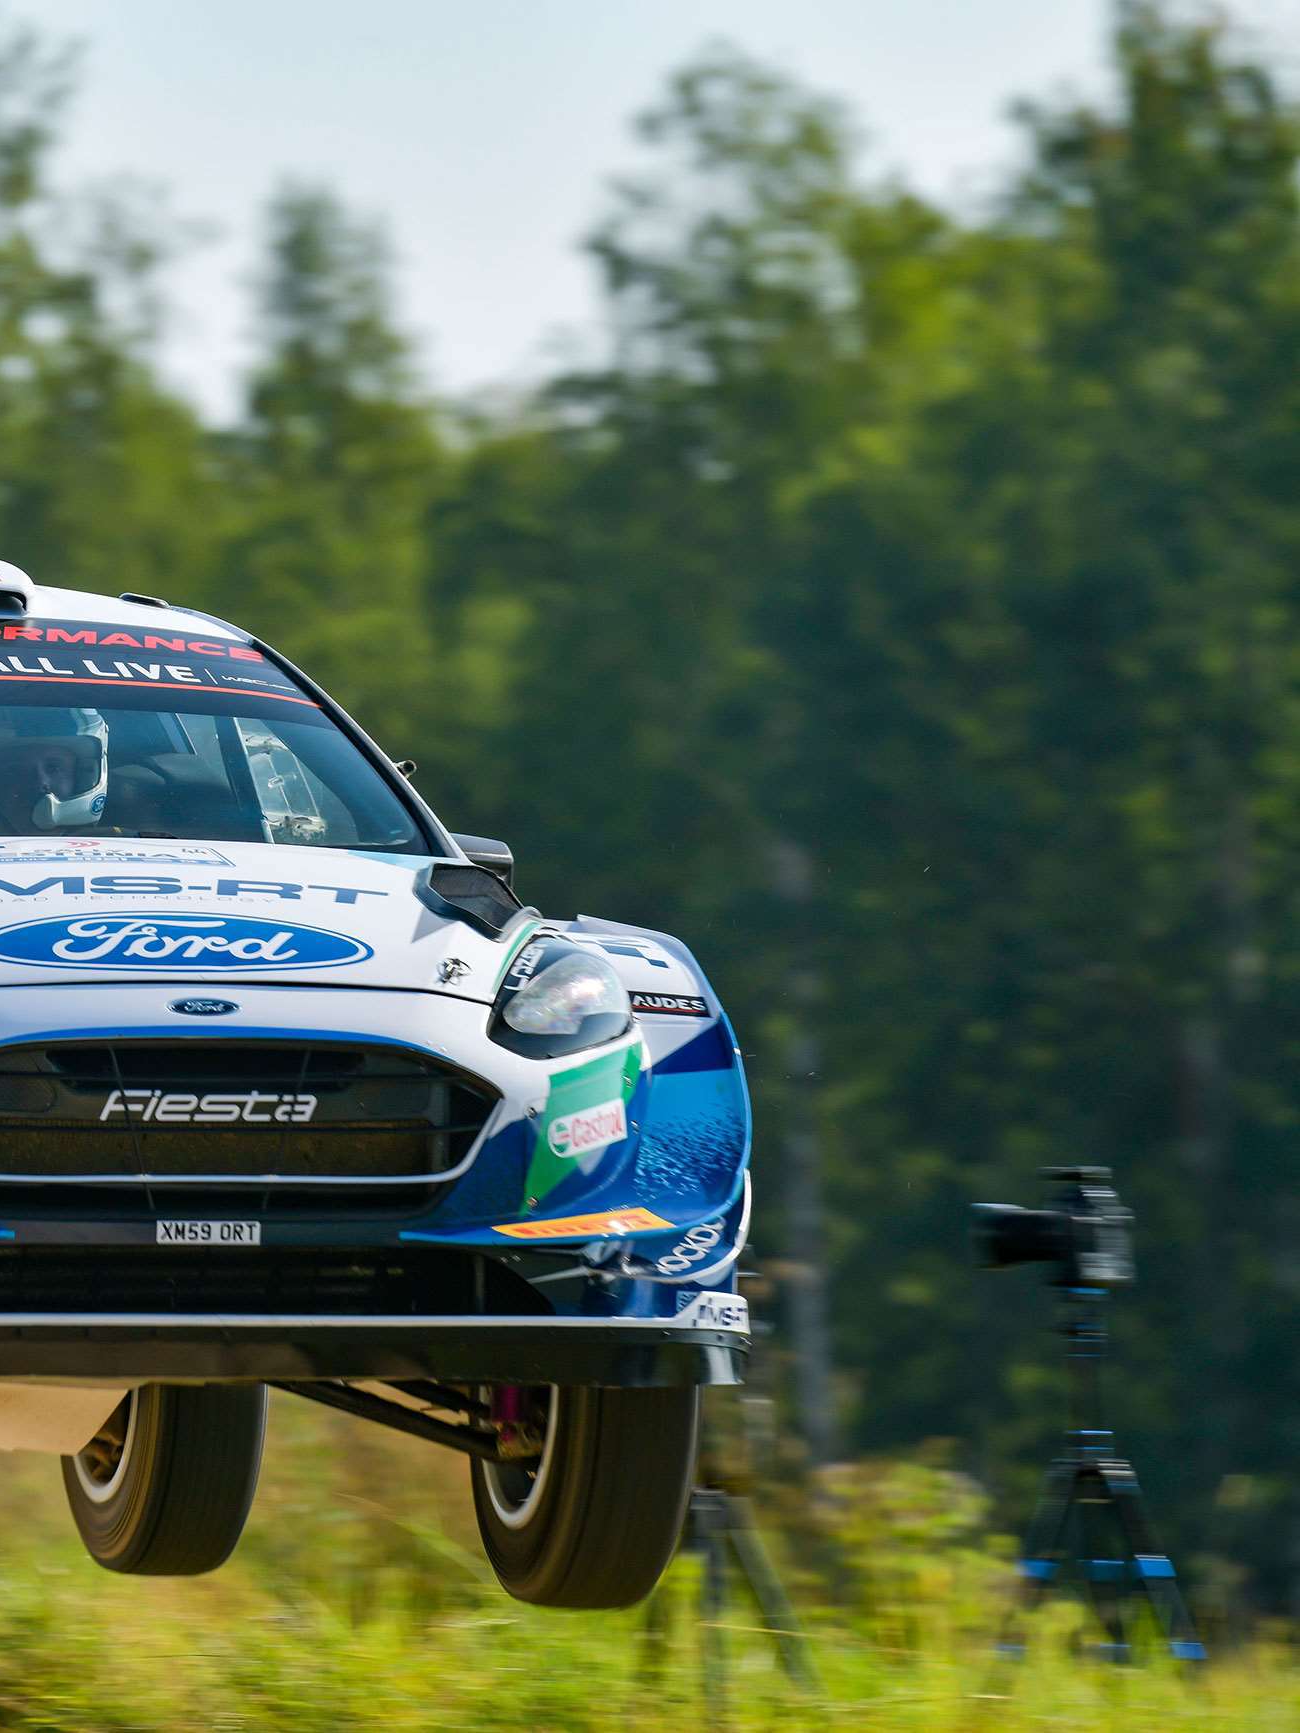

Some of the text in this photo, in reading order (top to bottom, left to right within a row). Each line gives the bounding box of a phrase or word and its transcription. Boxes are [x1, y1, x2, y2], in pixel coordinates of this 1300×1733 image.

[82, 659, 202, 683] LIVE
[53, 920, 300, 963] Ford
[100, 1090, 318, 1122] Fiesta
[161, 1224, 257, 1242] XM59 ORT
